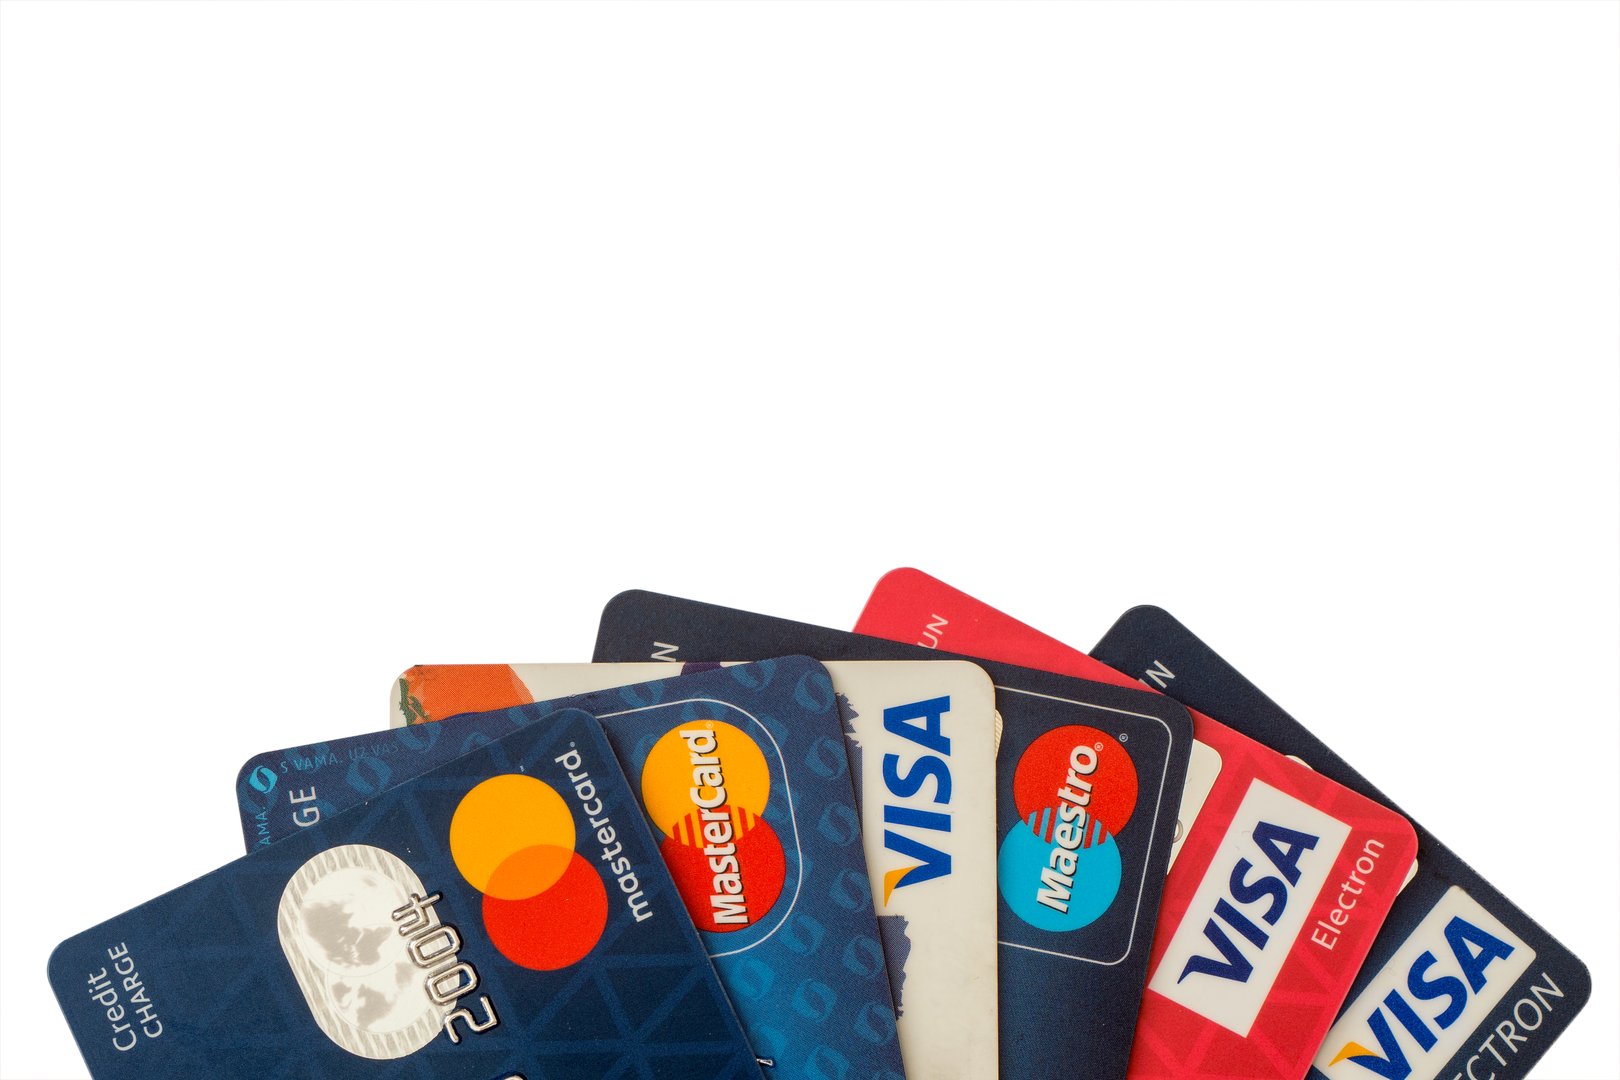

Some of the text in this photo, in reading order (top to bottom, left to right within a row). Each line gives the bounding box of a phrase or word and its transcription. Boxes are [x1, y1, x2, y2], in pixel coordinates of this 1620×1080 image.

[679, 728, 750, 925] MasterCard
[883, 694, 953, 908] VISA
[1036, 744, 1099, 915] Maestro
[391, 893, 499, 1045] 2004
[1177, 820, 1321, 985] VISA
[1310, 838, 1386, 951] Electron
[87, 966, 138, 1052] Credit
[108, 941, 164, 1039] CHARGE
[1327, 915, 1516, 1080] VISA
